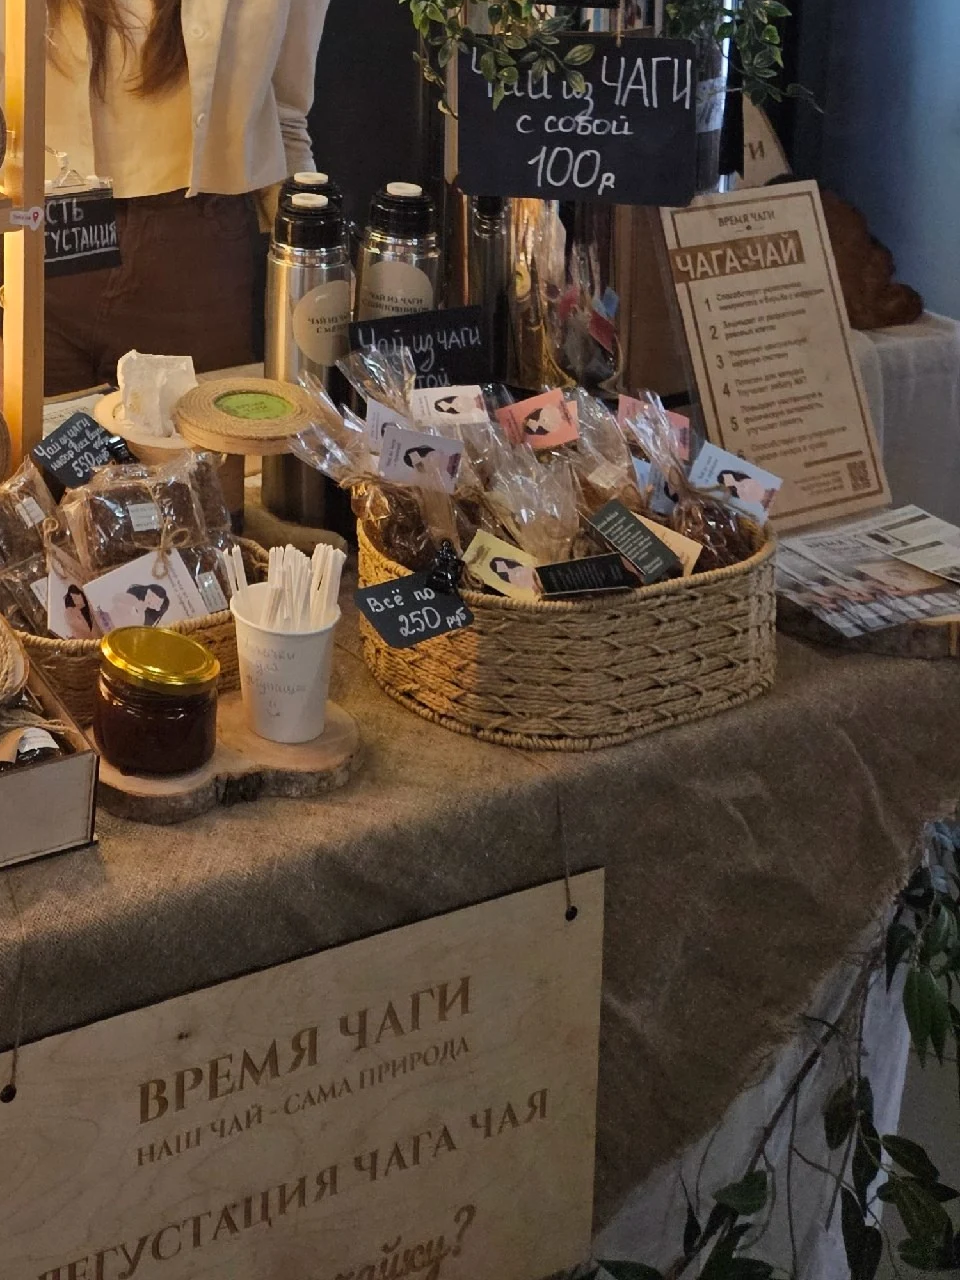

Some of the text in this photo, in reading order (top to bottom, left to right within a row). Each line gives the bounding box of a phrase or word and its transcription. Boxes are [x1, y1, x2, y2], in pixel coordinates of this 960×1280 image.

[602, 56, 692, 109] ЧАГИ
[515, 114, 634, 135] с собой
[45, 197, 84, 224] СТЬ
[718, 215, 750, 228] ВРЕМЯ
[45, 221, 117, 253] УСТАЦИЯ
[675, 234, 797, 279] ЧАГА-ЧАЙ
[437, 326, 482, 351] ЧАГИ
[709, 325, 719, 340] 2
[716, 354, 724, 370] 3
[723, 382, 731, 398] 4
[730, 417, 739, 432] 5
[366, 587, 435, 612] Всё по
[398, 606, 467, 637] 250 руб
[138, 976, 471, 1125] ВРЕМЯ ЧАГИ
[137, 1127, 201, 1167] НАШ
[210, 1104, 263, 1139] ЧАЙ
[283, 1076, 353, 1116] САМА
[360, 1035, 471, 1090] ПРИРОДА
[353, 1125, 458, 1183] ЧАГА
[469, 1088, 550, 1140] ЧАЯ
[336, 1204, 478, 1280] айку?
